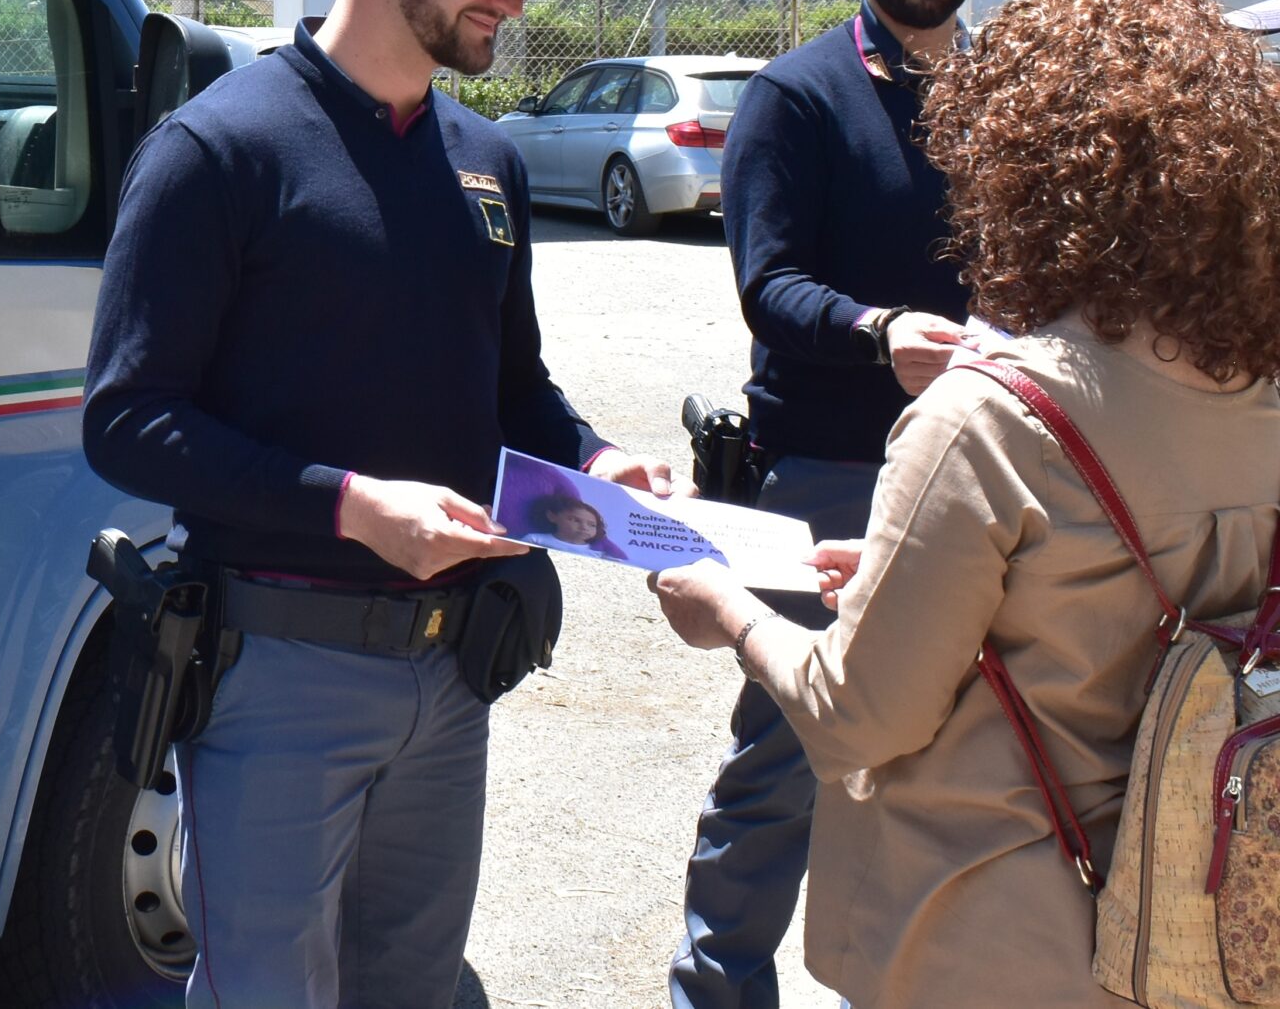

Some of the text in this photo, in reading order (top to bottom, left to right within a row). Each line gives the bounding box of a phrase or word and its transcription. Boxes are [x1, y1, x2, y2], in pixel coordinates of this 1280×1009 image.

[628, 512, 666, 523] Molto
[627, 527, 689, 542] qualcuno
[628, 520, 686, 535] vengono
[627, 539, 684, 552] AMICO
[690, 546, 703, 554] O
